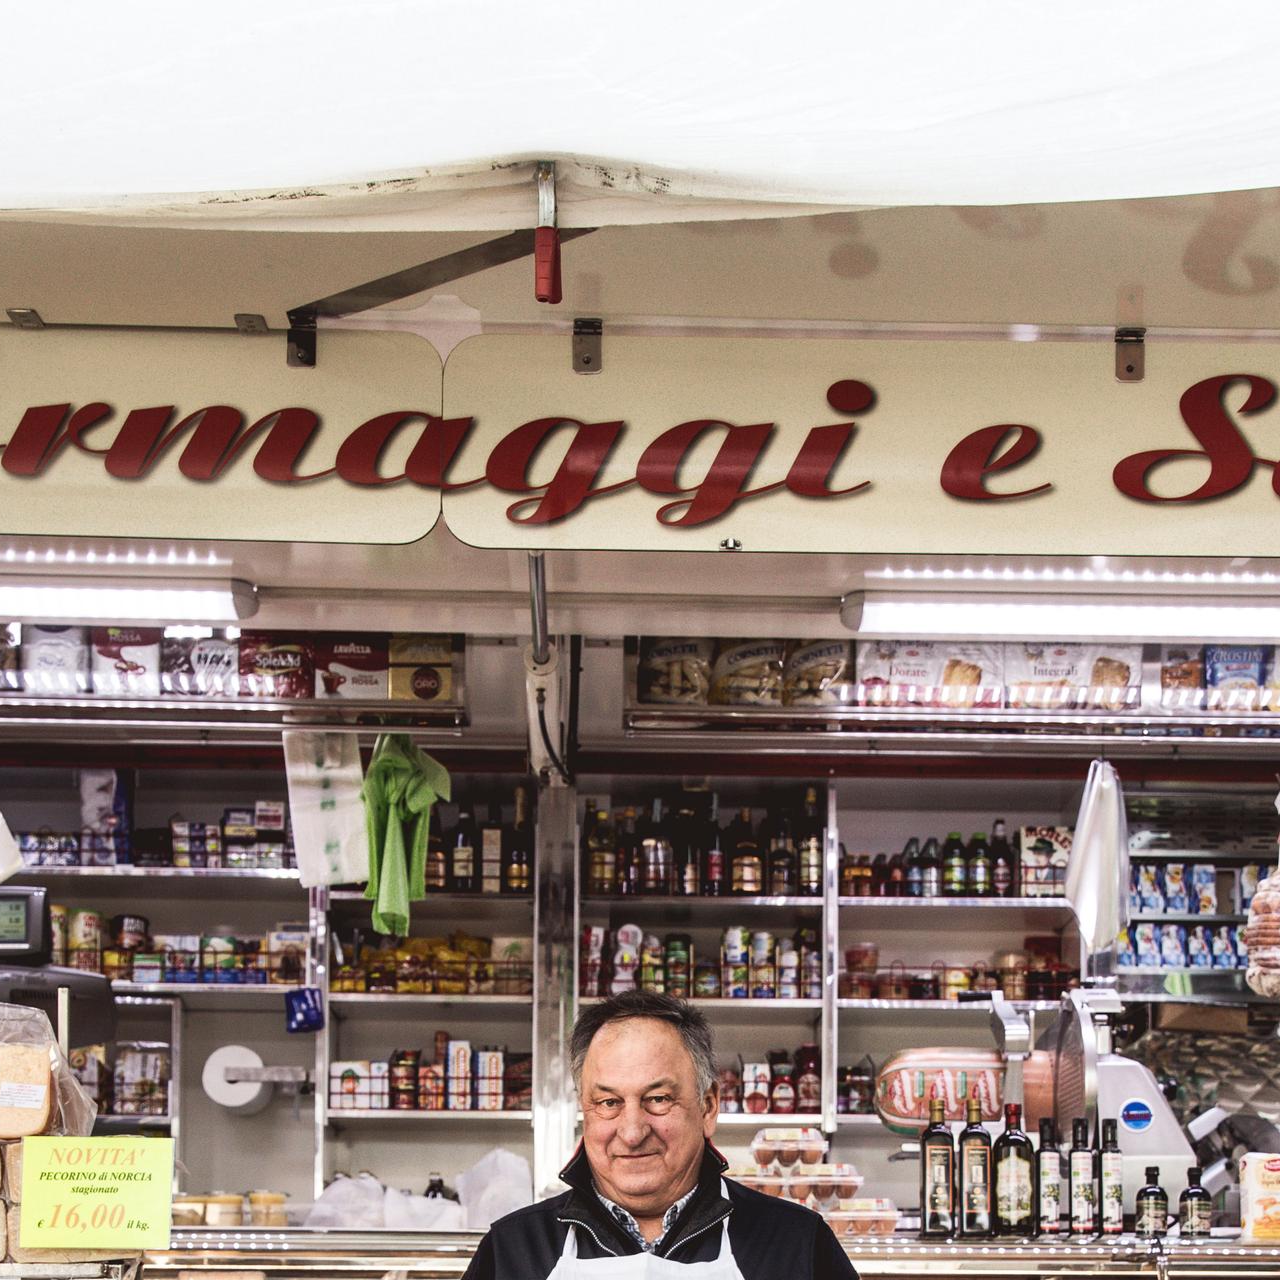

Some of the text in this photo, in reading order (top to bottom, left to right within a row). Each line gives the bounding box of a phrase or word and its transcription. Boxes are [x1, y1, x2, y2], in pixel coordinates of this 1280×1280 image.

[940, 424, 1052, 500] e
[889, 666, 928, 679] Dorate
[1033, 662, 1078, 678] Integrali
[48, 1147, 146, 1166] NOVITA'
[39, 1171, 153, 1182] PECORINO NORCIA
[70, 1184, 119, 1195] stagionato
[48, 1202, 126, 1233] 16,00
